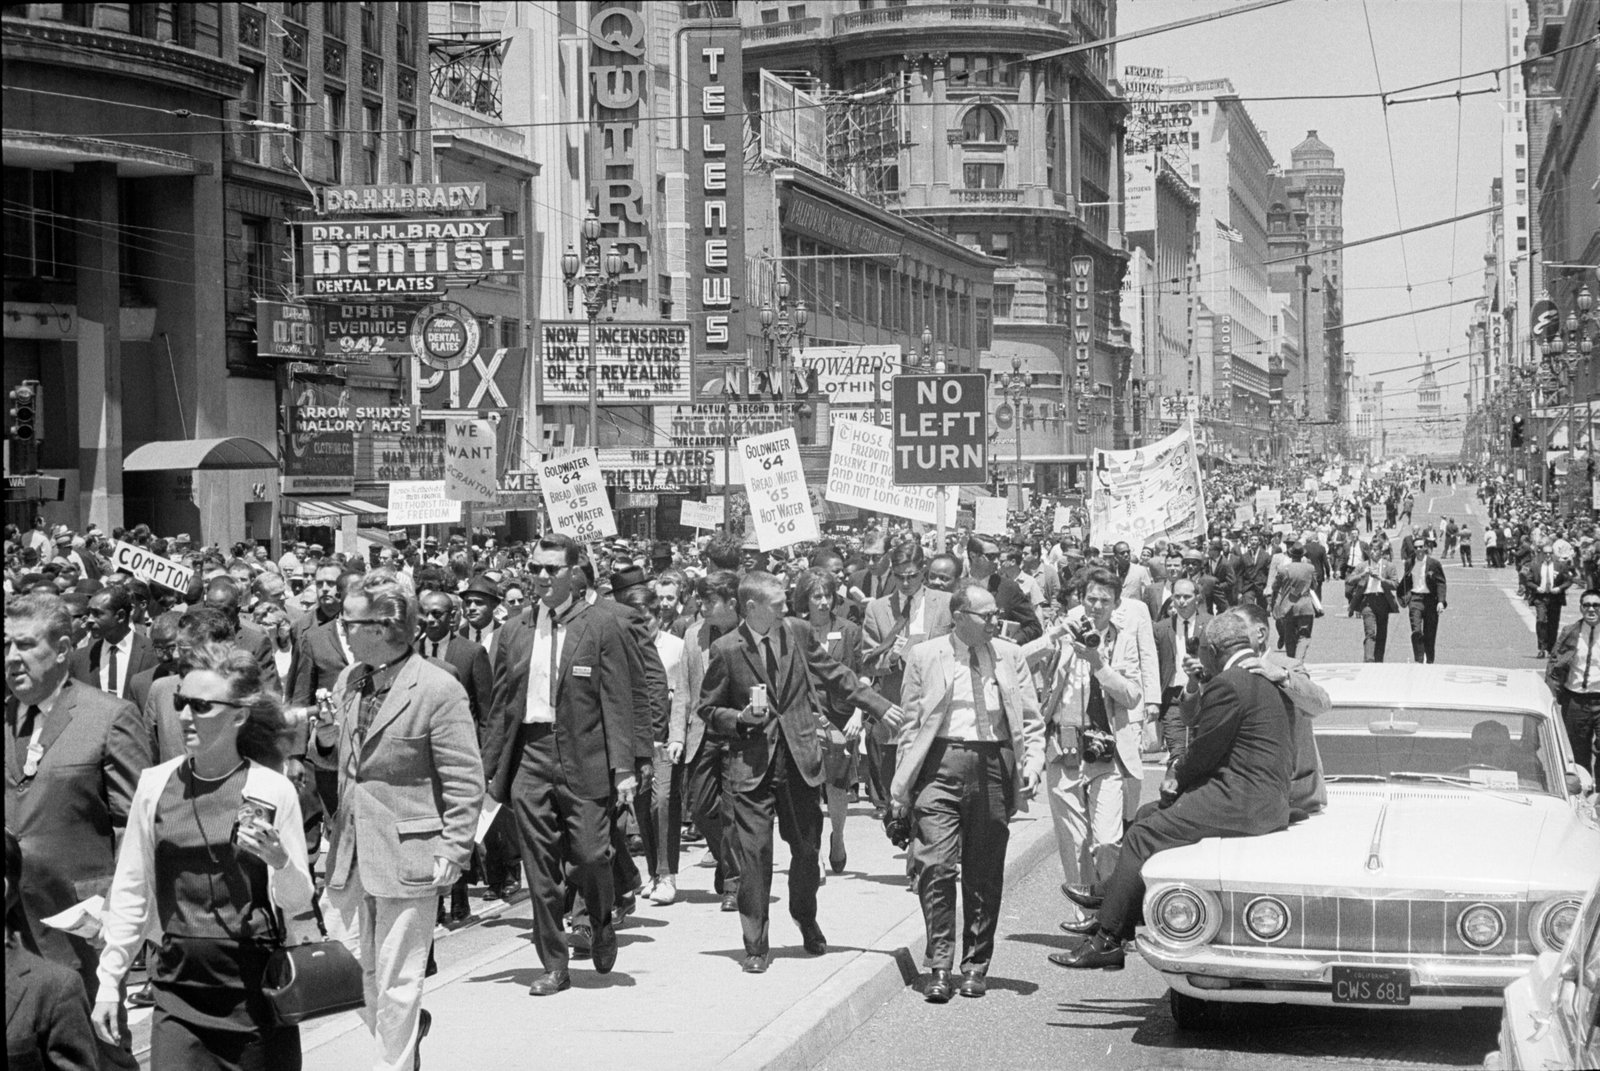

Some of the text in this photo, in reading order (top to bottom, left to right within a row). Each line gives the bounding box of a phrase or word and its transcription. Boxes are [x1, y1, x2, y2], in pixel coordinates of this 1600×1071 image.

[702, 47, 731, 343] TELENEWS
[313, 241, 510, 274] DENTIST
[317, 277, 434, 292] DENTAL PLATES
[341, 305, 394, 318] OPEN
[329, 321, 407, 334] EVENINGS
[546, 327, 686, 344] NOW UNCENSORED
[339, 336, 386, 352] 942
[428, 333, 461, 342] DENTAL
[431, 342, 459, 351] PLATES
[802, 352, 896, 376] HOWARD'S
[411, 348, 508, 408] PIX
[601, 365, 680, 381] REVEALING
[724, 366, 809, 396] NEWS
[607, 382, 625, 392] THE
[629, 388, 651, 398] WILD
[917, 380, 963, 404] NO
[297, 407, 411, 418] ARROW SHIRTS
[677, 405, 682, 414] A
[737, 404, 769, 413] RECORD
[297, 420, 366, 431] MALLORY
[372, 420, 411, 431] HATS
[455, 424, 478, 437] WE
[671, 421, 706, 435] TRUE
[900, 412, 981, 437] LEFT
[447, 445, 492, 459] WANT
[745, 439, 791, 459] GOLDWATER
[851, 443, 890, 463] FREEDOM
[896, 444, 983, 469] TURN
[630, 450, 715, 466] THE LOVERS
[759, 455, 784, 470] '64
[834, 454, 867, 471] DESERVE
[870, 462, 878, 474] IT
[544, 457, 589, 478] GOLDWATER
[447, 464, 494, 498] SCRANTON
[559, 471, 581, 484] '64
[665, 469, 714, 485] ADULT
[750, 470, 799, 492] BREAD WATER
[832, 467, 853, 480] AND
[856, 472, 885, 488] UNDER
[550, 482, 597, 503] BREAD WATER
[766, 487, 789, 502] '65
[830, 479, 935, 513] CAN NOT LONG RETAIN
[566, 496, 588, 509] '65
[408, 508, 449, 519] FREEDOM
[558, 507, 604, 528] HOT WATER
[761, 503, 804, 523] HOT WATER
[573, 521, 594, 534] '66
[774, 519, 796, 534] '66
[119, 548, 190, 592] COMPTON
[1354, 972, 1389, 980] CALIFORNIA
[1337, 981, 1405, 1000] CWS 681
